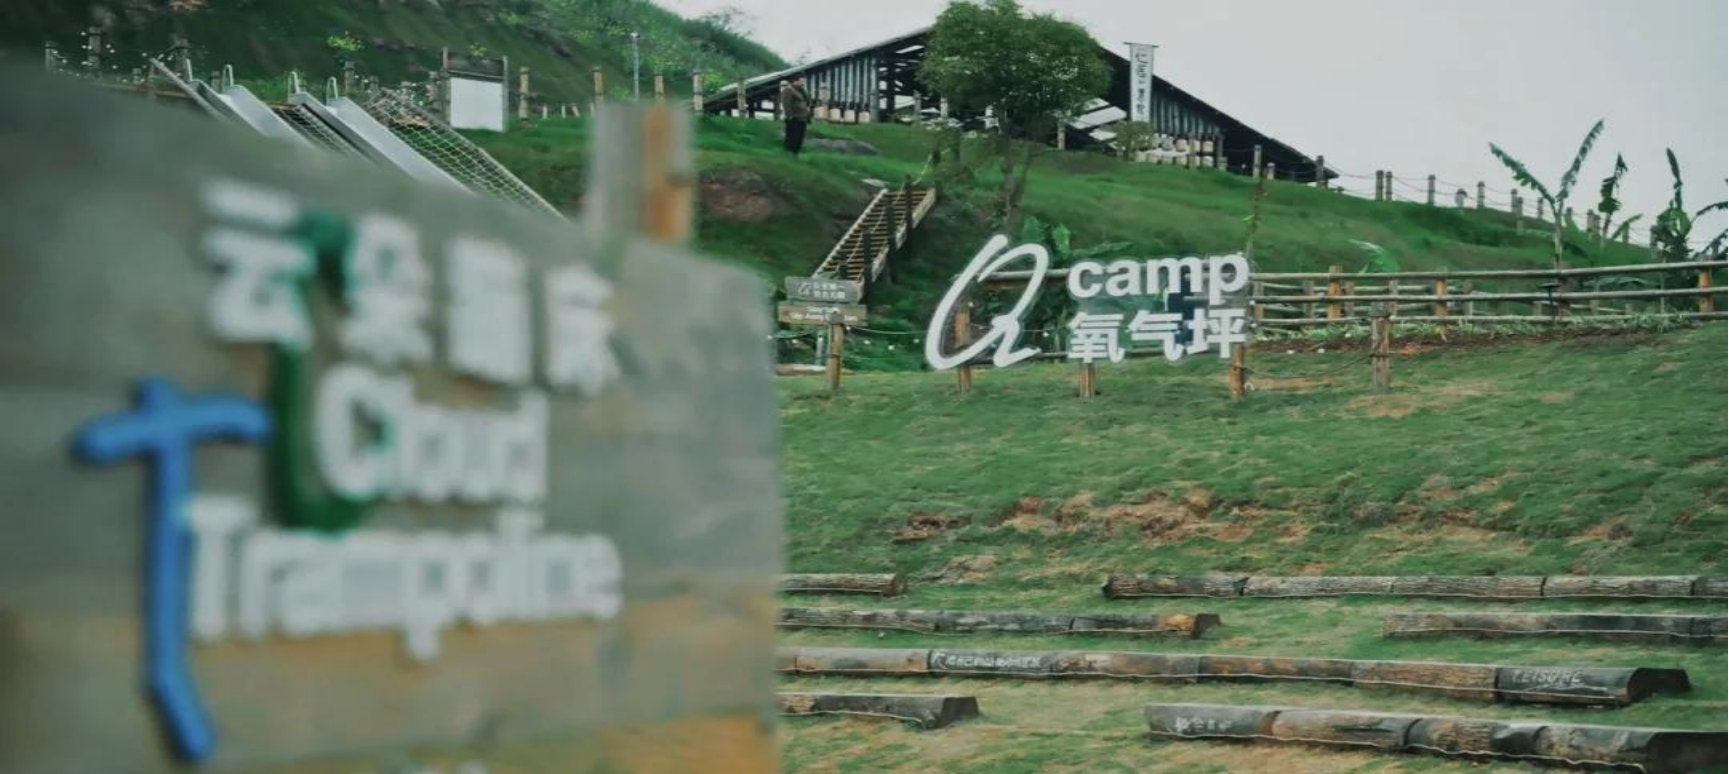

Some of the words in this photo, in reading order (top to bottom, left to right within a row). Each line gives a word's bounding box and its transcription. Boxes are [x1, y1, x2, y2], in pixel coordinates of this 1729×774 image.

[1068, 253, 1250, 306] camp
[1068, 308, 1247, 364] 氧气坪
